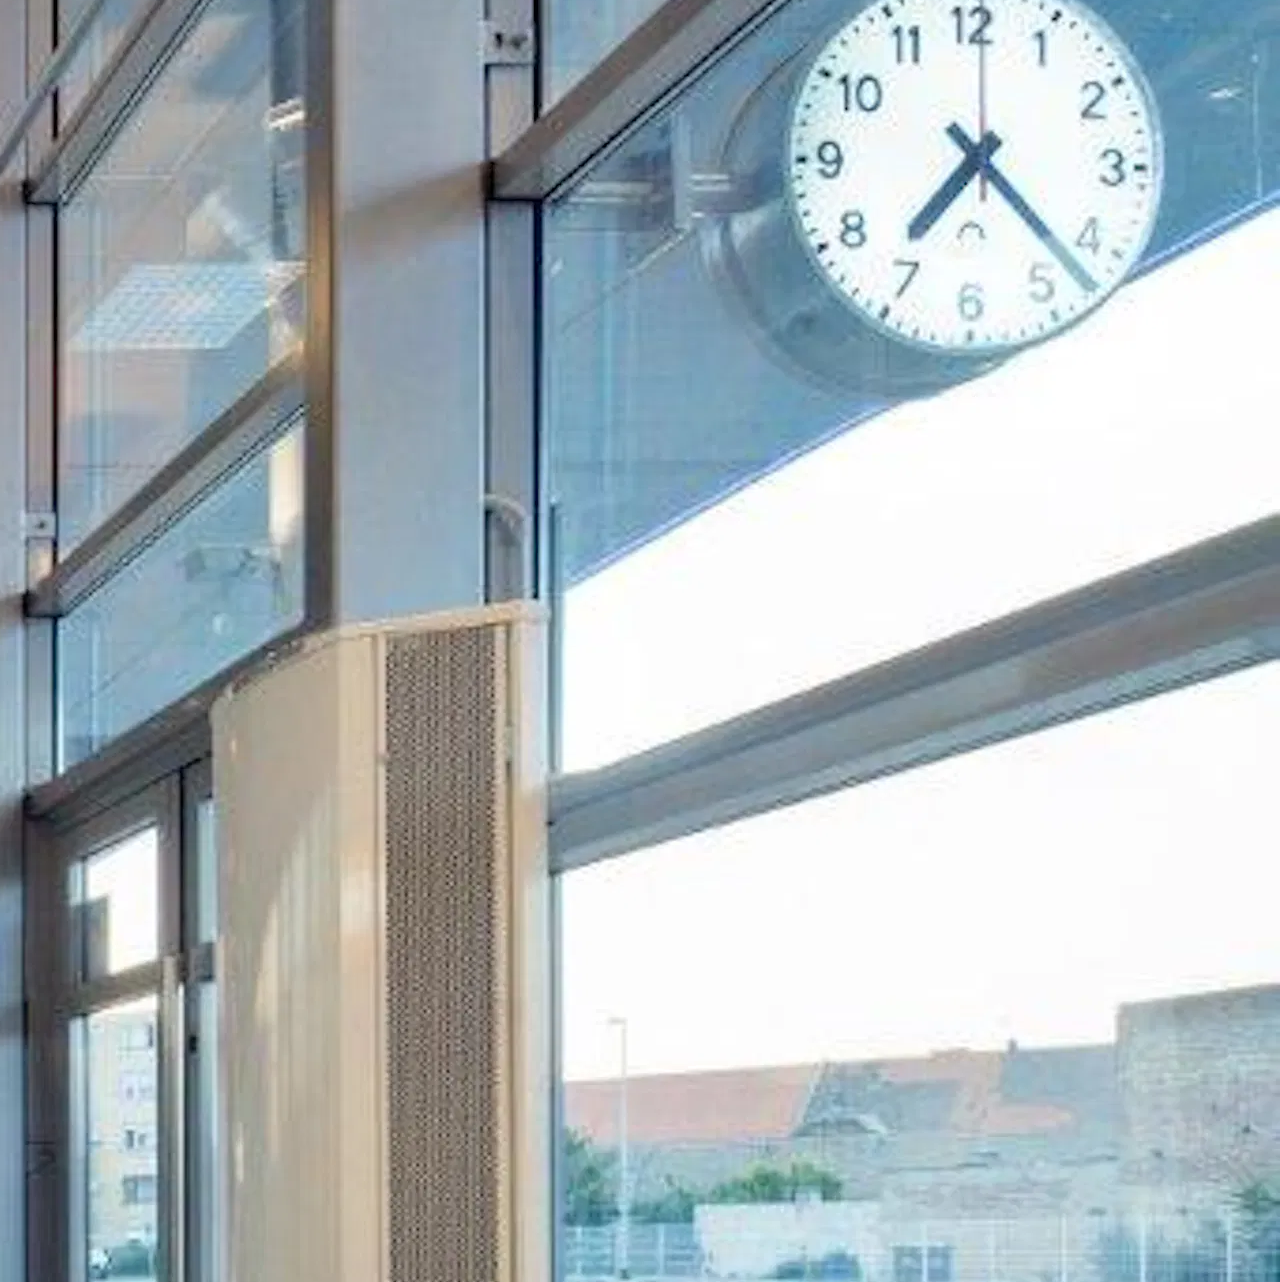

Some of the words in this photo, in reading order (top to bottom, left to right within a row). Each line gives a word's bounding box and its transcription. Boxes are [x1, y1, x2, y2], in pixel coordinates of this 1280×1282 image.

[892, 25, 922, 66] 11
[950, 6, 994, 46] 12
[1033, 29, 1047, 67] 1
[839, 74, 882, 112] 10
[1080, 81, 1106, 119] 2
[817, 141, 844, 179] 9
[1098, 148, 1126, 187] 3
[839, 211, 866, 249] 8
[1075, 215, 1101, 256] 4
[893, 259, 920, 298] 7
[1028, 261, 1056, 303] 5
[957, 283, 985, 322] 6
